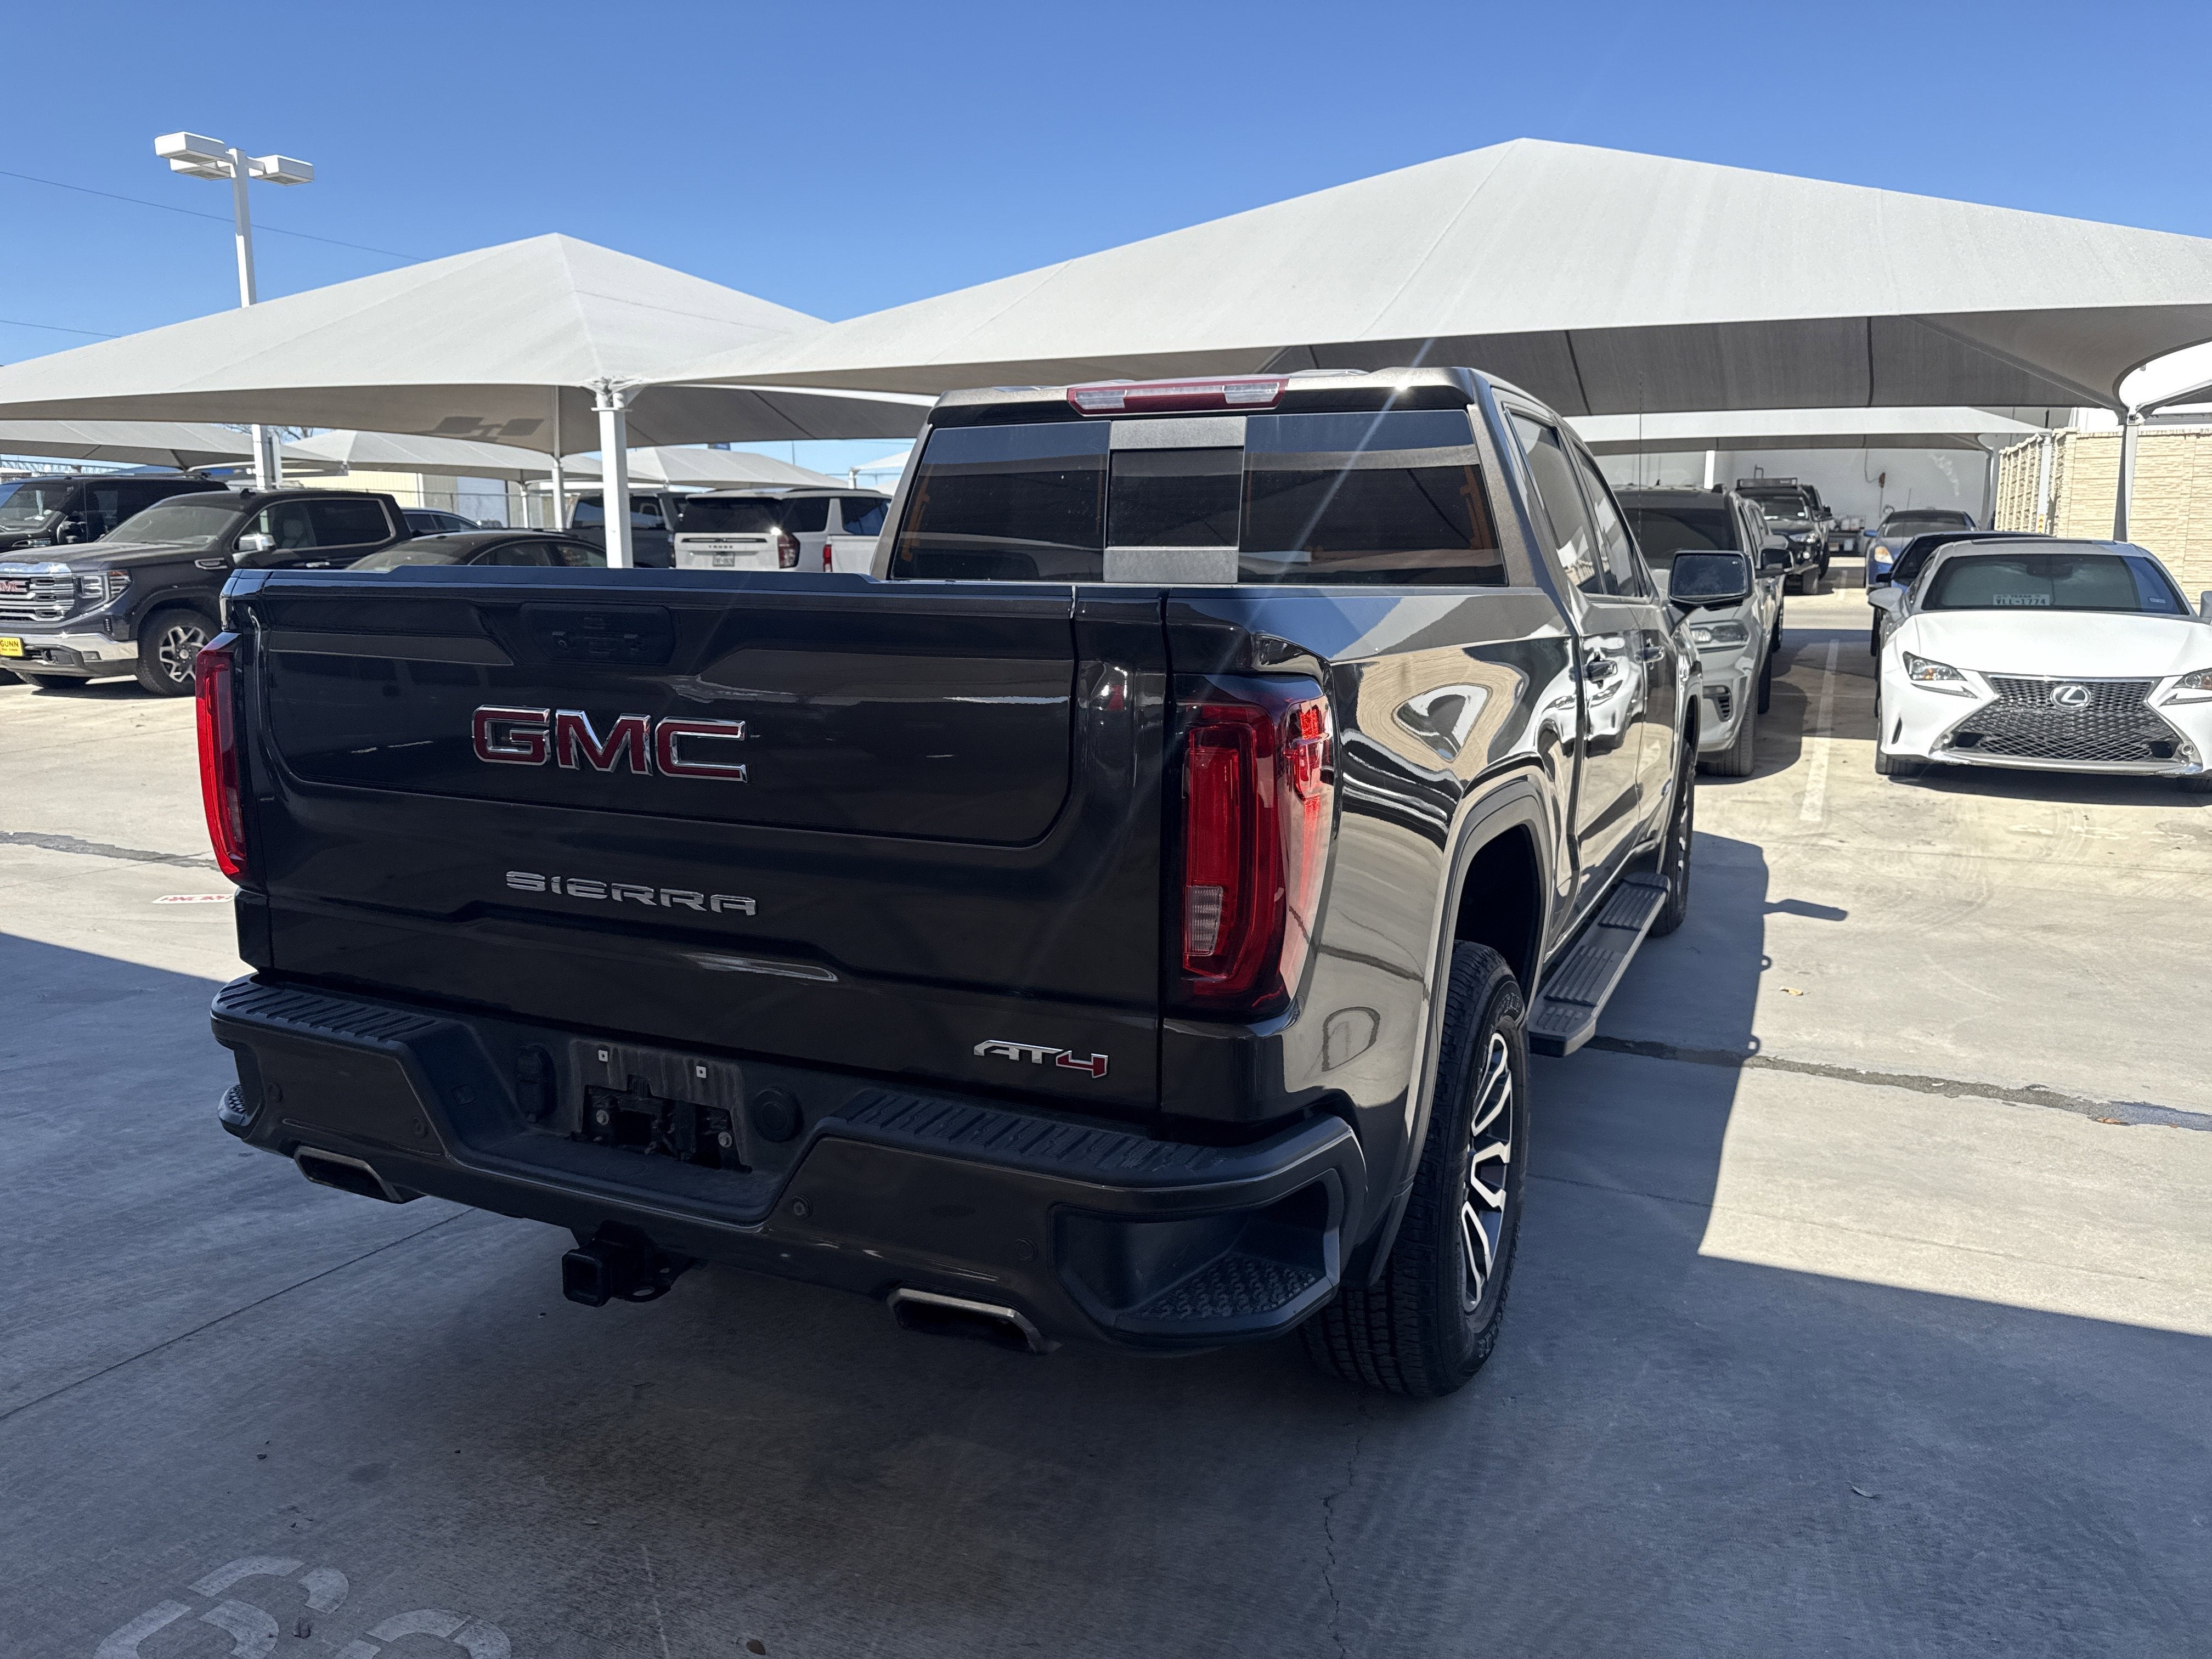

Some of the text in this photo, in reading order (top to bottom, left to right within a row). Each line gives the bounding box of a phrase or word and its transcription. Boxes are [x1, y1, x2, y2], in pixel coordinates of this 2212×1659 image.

[0, 580, 27, 592] MC
[472, 704, 748, 783] GMC
[506, 871, 757, 916] SIERRA
[974, 1040, 1108, 1079] AT4
